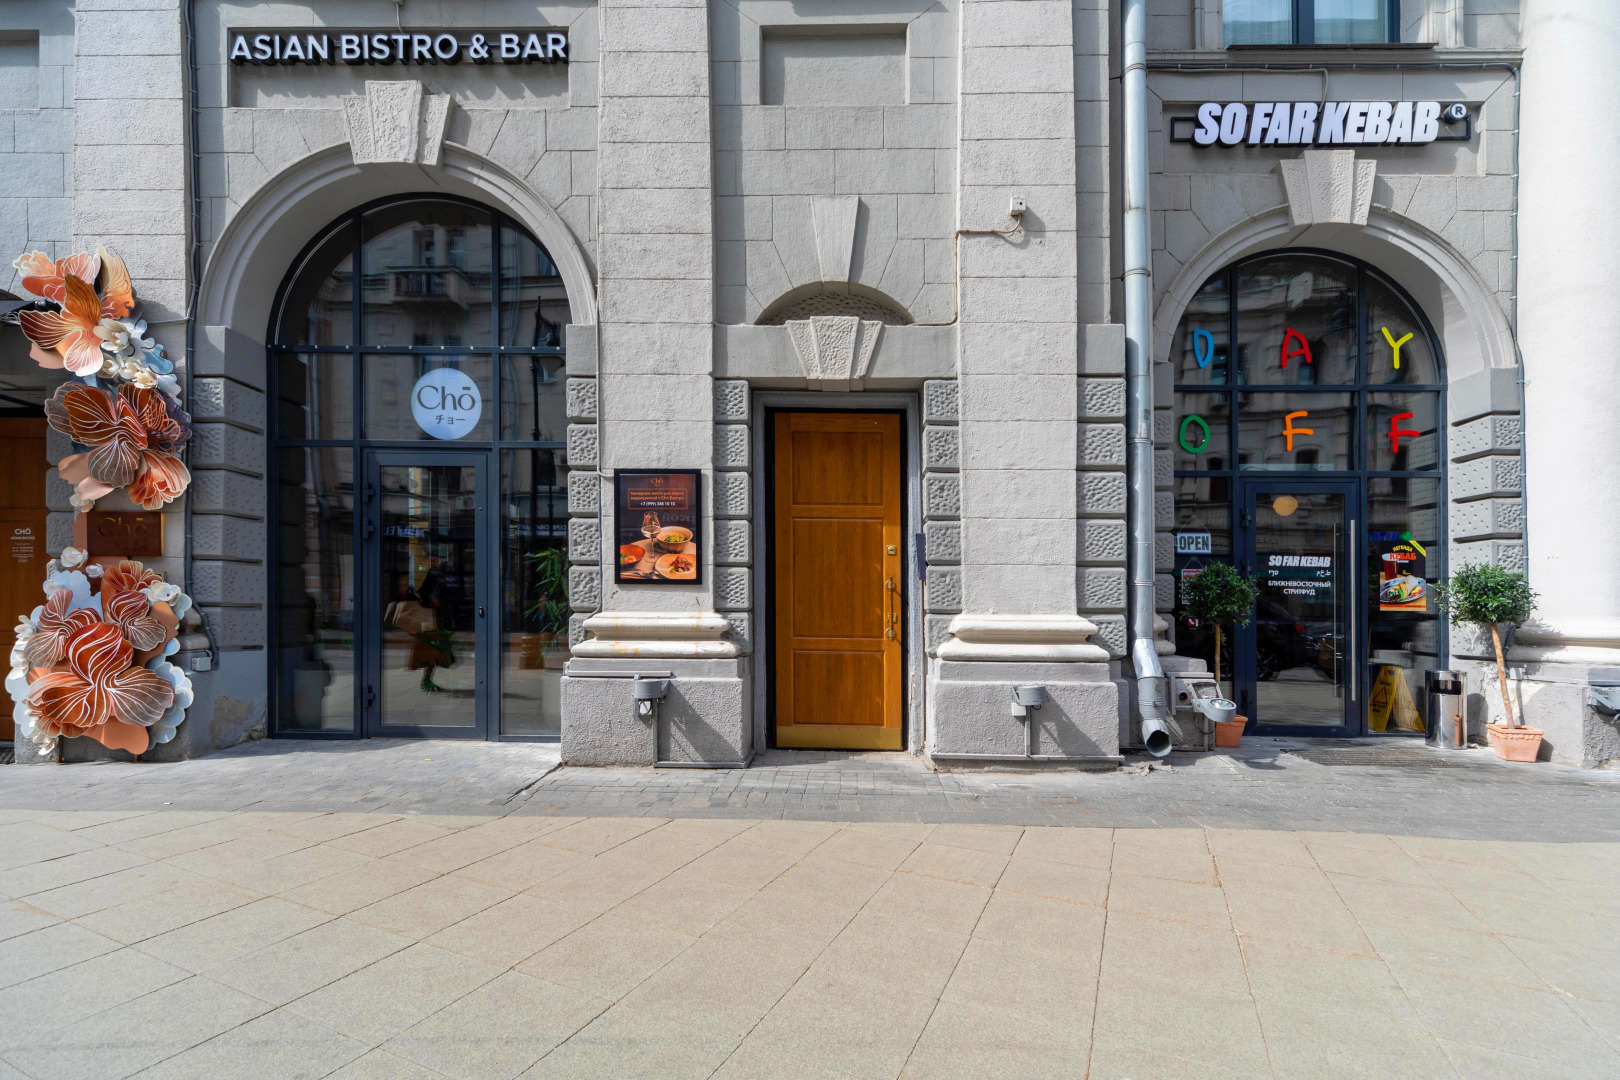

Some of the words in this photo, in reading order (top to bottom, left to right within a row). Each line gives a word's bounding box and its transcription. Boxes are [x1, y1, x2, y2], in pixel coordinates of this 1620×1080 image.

[230, 34, 328, 60] ASIAN
[340, 33, 458, 60] BISTRO
[469, 33, 489, 59] &
[500, 33, 567, 58] BAR
[1194, 102, 1248, 145] SO
[1249, 101, 1319, 144] FAR
[1318, 101, 1441, 143] KEBAB
[417, 385, 476, 411] Chō
[435, 414, 466, 425] チョー
[1179, 535, 1210, 551] OPEN
[1268, 555, 1283, 567] SO
[1282, 555, 1300, 567] FAR
[1300, 555, 1332, 568] KEBAB
[1389, 552, 1417, 561] КЕБАБ
[1268, 580, 1331, 588] БЛИЖНЕВОСТОЧНЫЙ
[1283, 588, 1316, 596] СТРИТФУД
